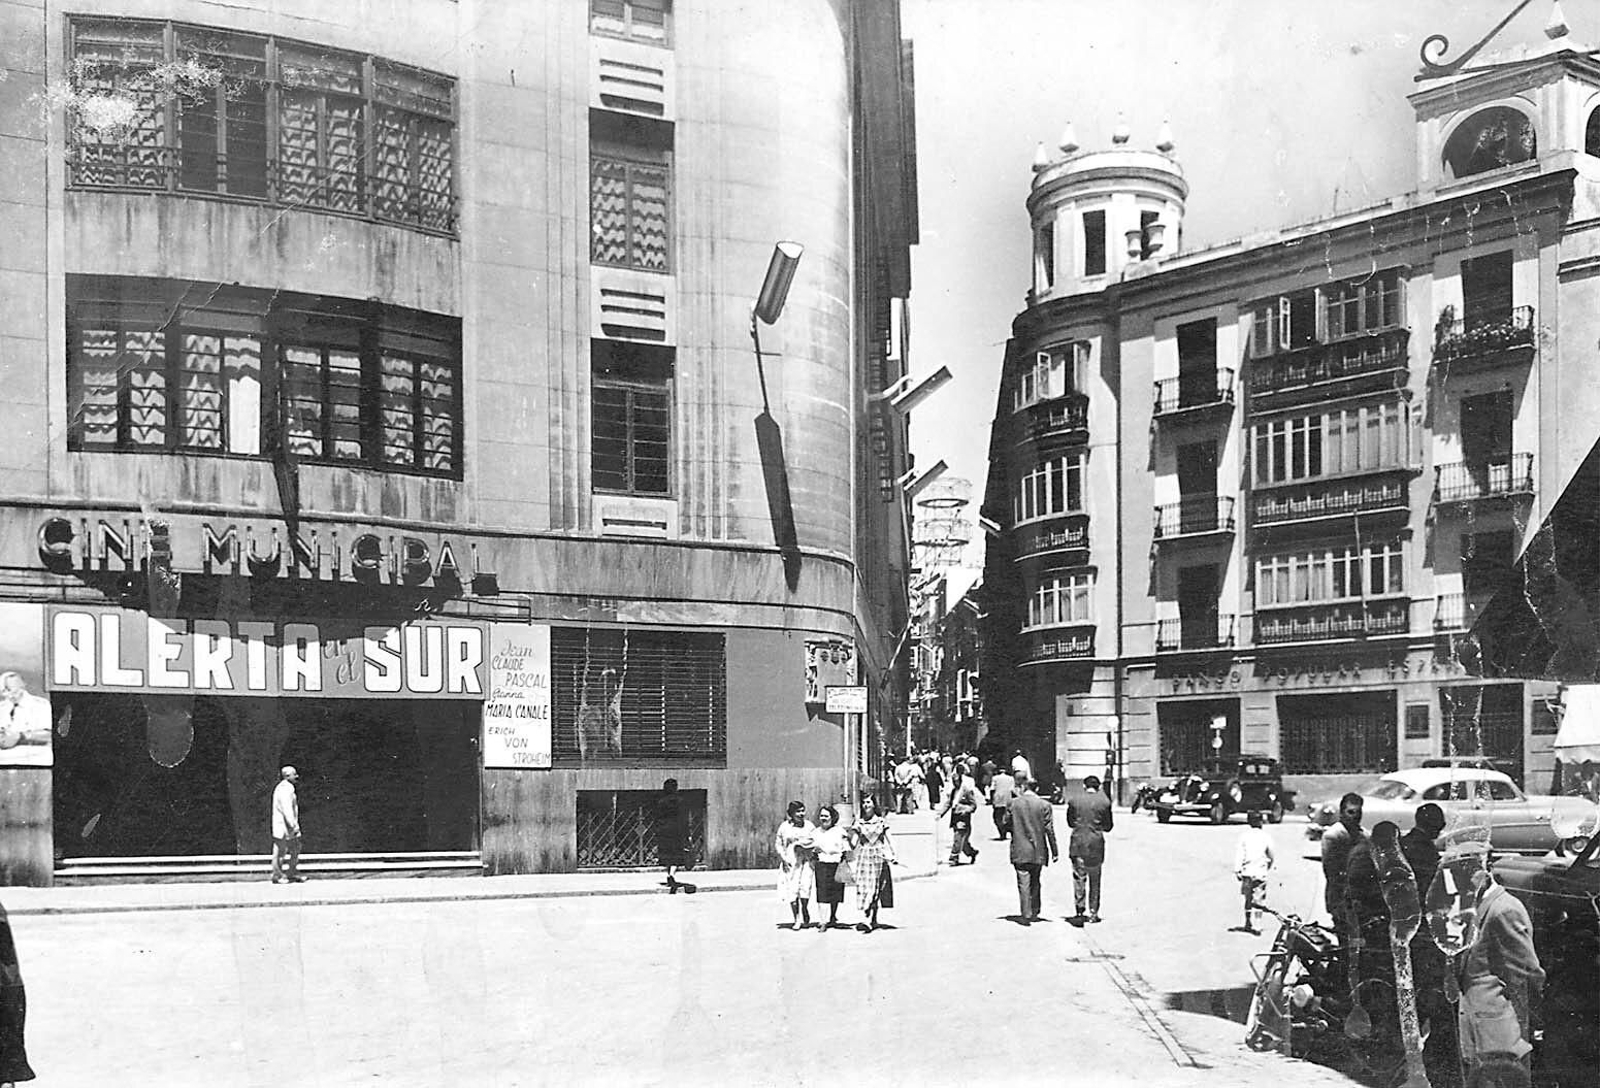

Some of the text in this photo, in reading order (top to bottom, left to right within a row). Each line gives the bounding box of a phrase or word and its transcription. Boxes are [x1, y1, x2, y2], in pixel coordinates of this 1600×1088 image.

[37, 517, 497, 579] CINE MUNICIPAL
[53, 610, 323, 693] ALERTA
[363, 625, 484, 695] SUR
[492, 655, 525, 671] CLAUDE
[505, 671, 548, 689] PASCAL
[485, 703, 549, 720] MARIA CANALE
[488, 726, 516, 736] ERICH
[504, 737, 529, 749] VON
[512, 751, 551, 766] STROHEIM
